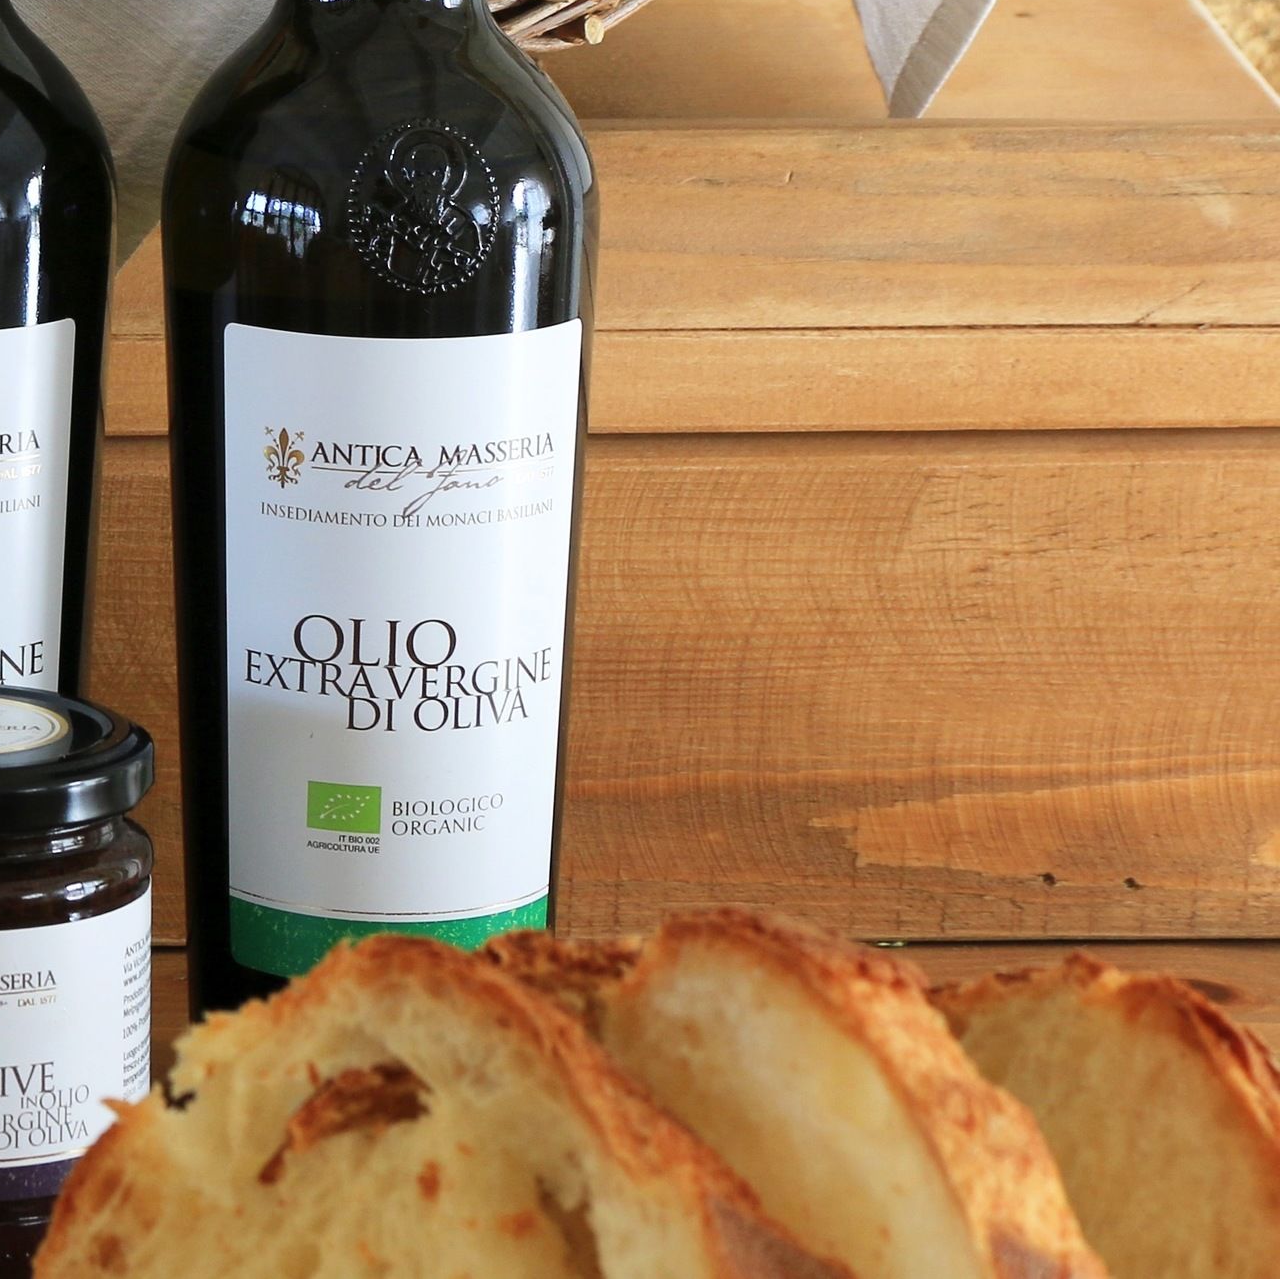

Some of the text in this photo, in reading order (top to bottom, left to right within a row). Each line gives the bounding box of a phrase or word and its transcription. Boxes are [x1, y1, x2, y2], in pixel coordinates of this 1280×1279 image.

[311, 432, 554, 468] ANTICA MASSERIA
[344, 458, 423, 492] del
[261, 498, 553, 528] INSEDIAMENTO DEI MONACI BASILIANI
[293, 614, 457, 667] OLIO
[346, 687, 529, 732] DI OLIVA
[392, 793, 504, 817] BIOLOGICO
[392, 815, 485, 837] ORGANIC
[307, 840, 380, 854] AGRICOLTURA UE
[348, 835, 363, 844] BIO
[365, 837, 380, 845] 002
[39, 1084, 90, 1110] OLIO
[28, 1122, 89, 1148] OLIVA
